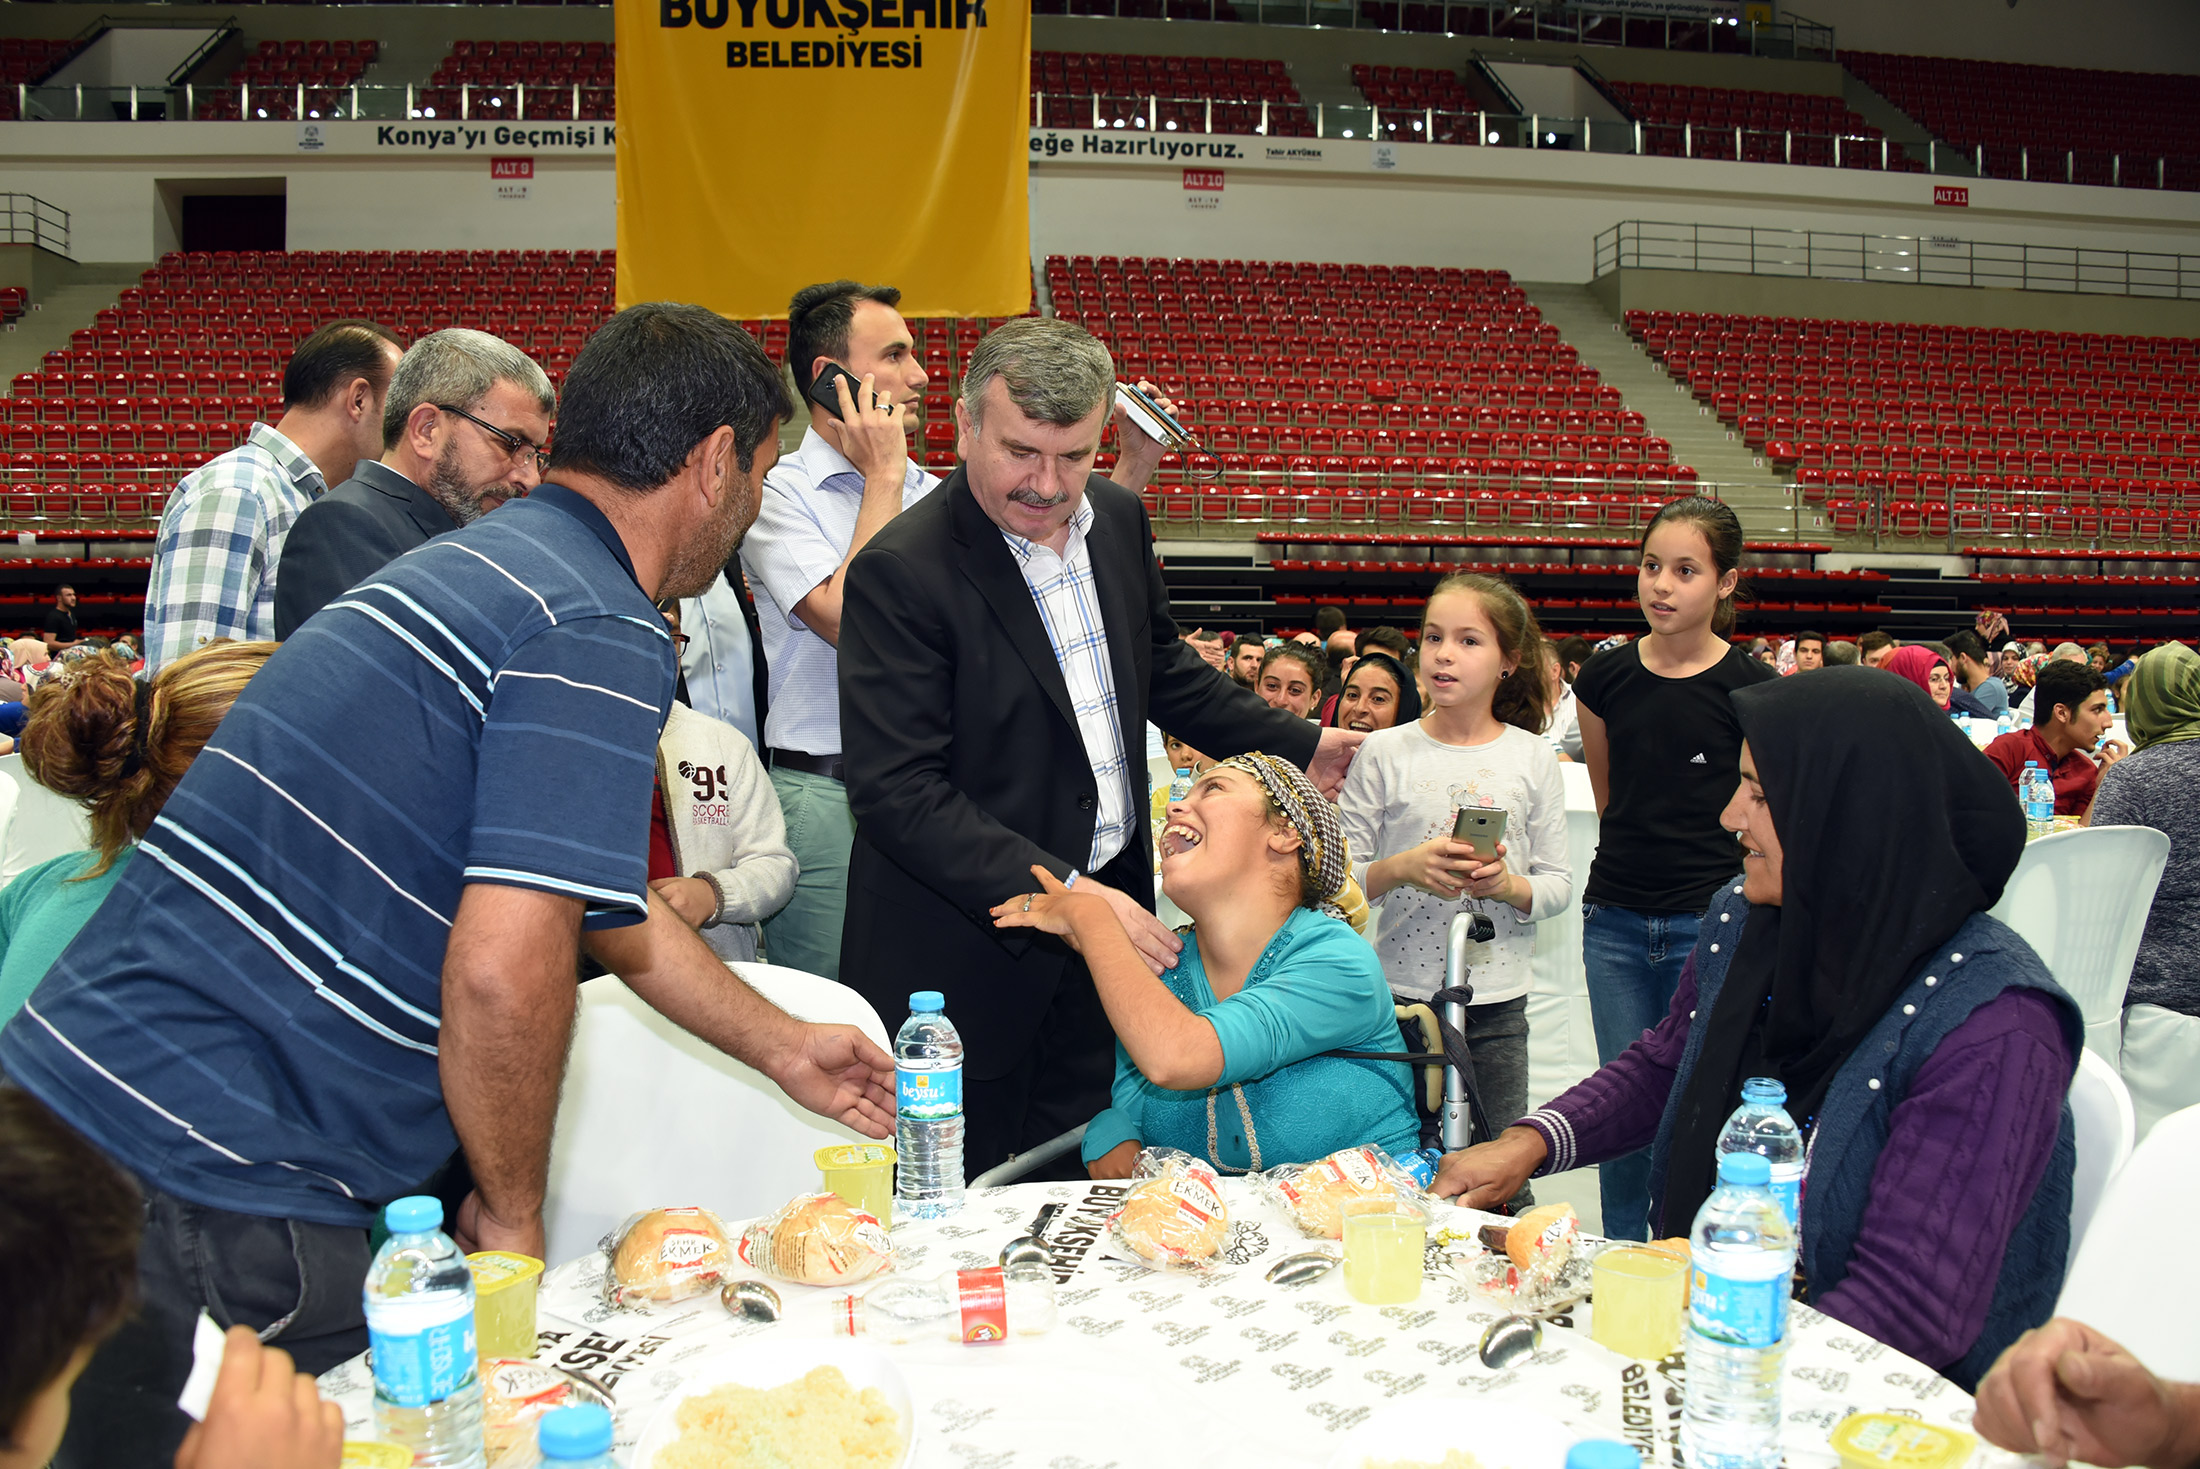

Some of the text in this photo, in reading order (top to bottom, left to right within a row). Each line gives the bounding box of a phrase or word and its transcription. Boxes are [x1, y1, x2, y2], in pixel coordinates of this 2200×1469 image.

[727, 35, 922, 68] BELEDİYESİ
[494, 126, 595, 148] Geçmişi
[1082, 134, 1244, 160] Hazırlıyoruz.
[495, 162, 530, 175] ALT 9
[1185, 173, 1223, 187] ALT 10
[1935, 190, 1967, 203] ALT 11
[902, 1081, 938, 1101] beysu
[1173, 1181, 1221, 1217] EKMEK
[660, 1242, 713, 1260] EKMEK
[1622, 1363, 1655, 1464] BELEDİYE
